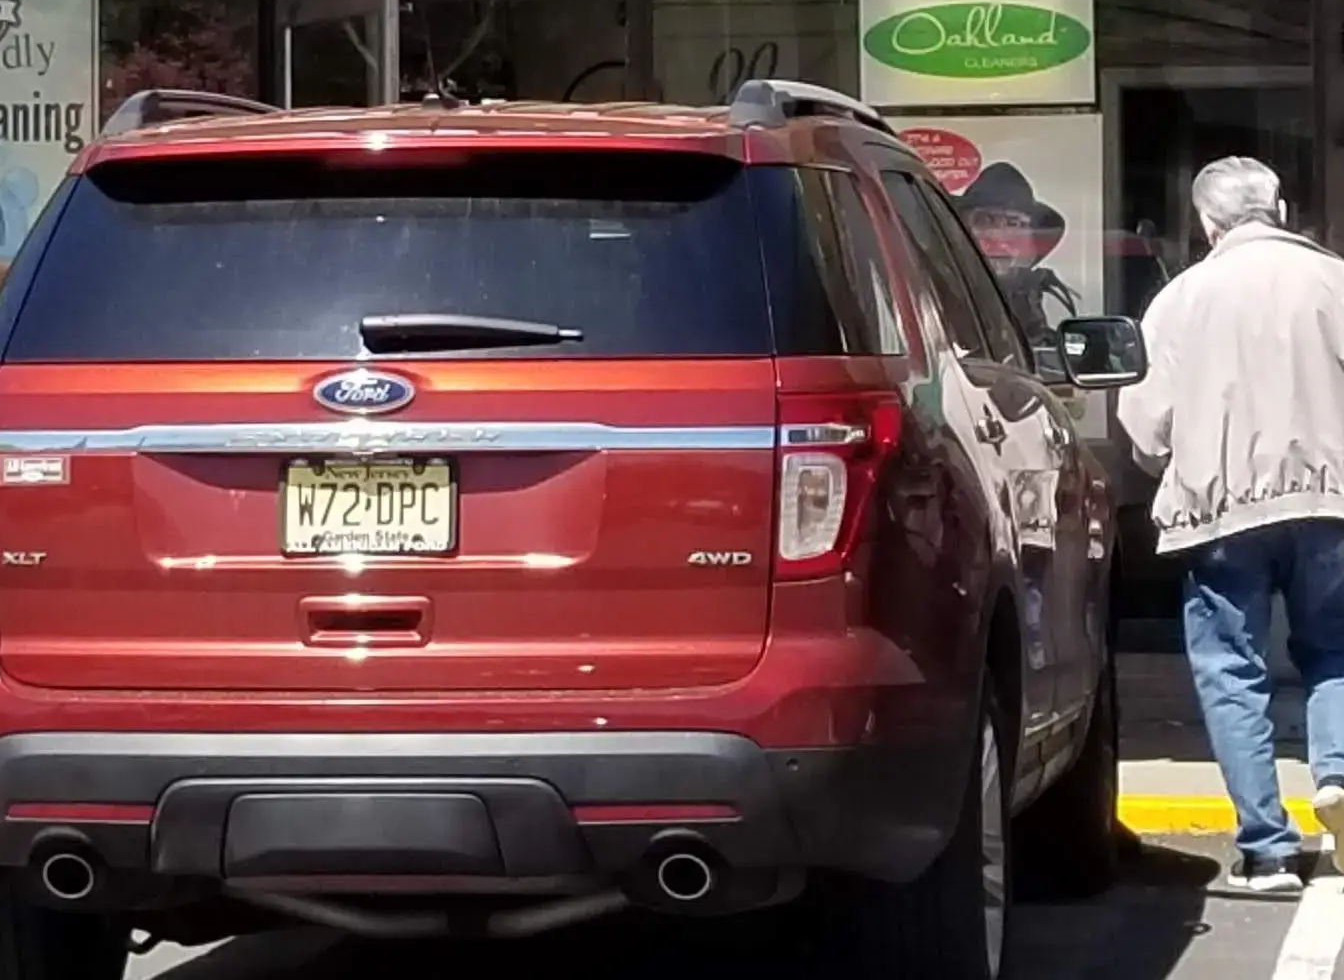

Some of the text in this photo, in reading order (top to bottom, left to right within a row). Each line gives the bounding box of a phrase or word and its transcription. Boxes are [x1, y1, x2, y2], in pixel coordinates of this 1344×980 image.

[892, 2, 1058, 55] Oakland
[964, 57, 1038, 69] CLEANERS
[333, 376, 392, 402] Ford
[1, 550, 47, 565] XLT
[687, 551, 752, 565] 4WD
